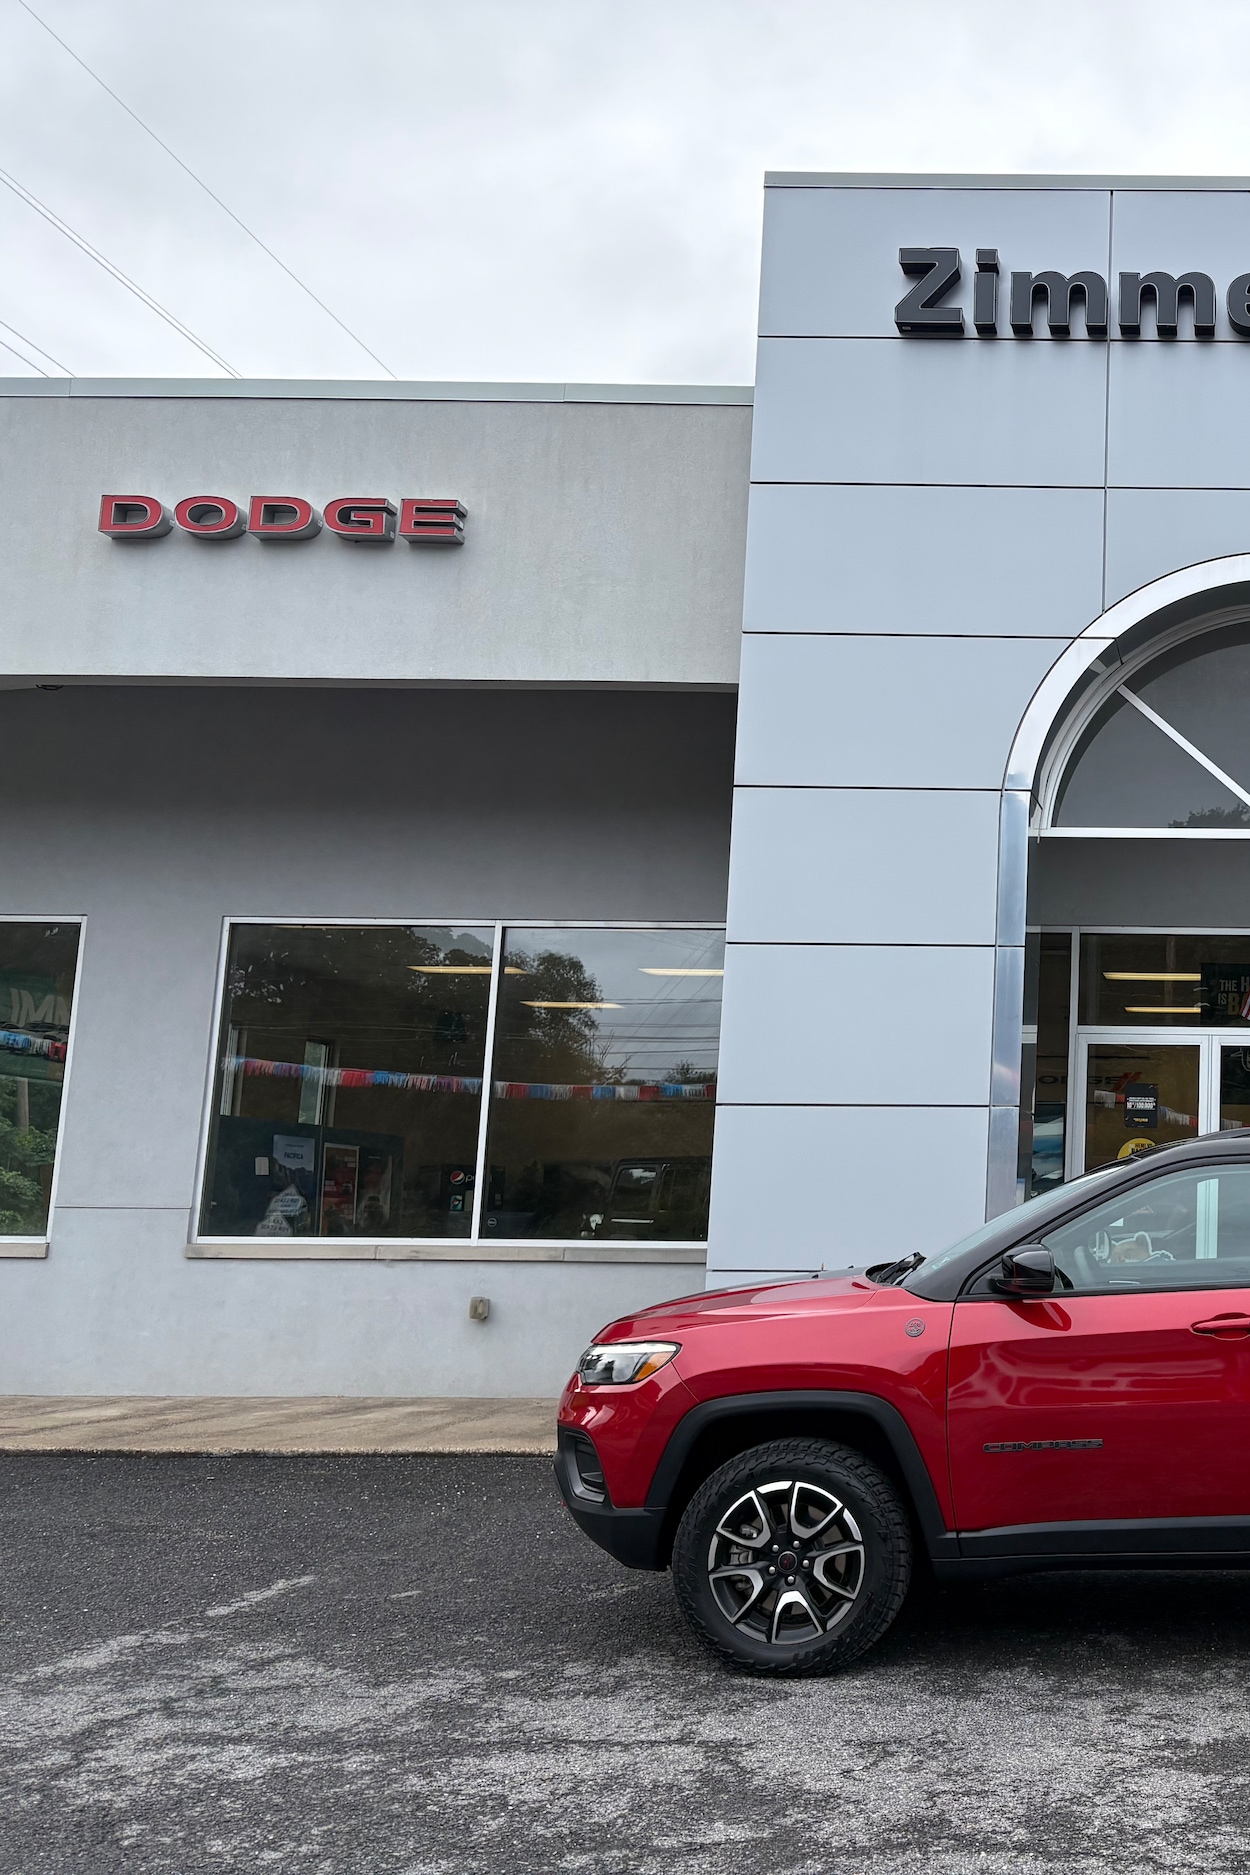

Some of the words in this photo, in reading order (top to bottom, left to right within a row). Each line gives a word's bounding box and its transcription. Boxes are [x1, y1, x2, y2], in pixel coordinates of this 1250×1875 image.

[98, 494, 468, 544] DODGE
[1220, 979, 1238, 991] THE
[983, 1439, 1103, 1452] COMPASS
